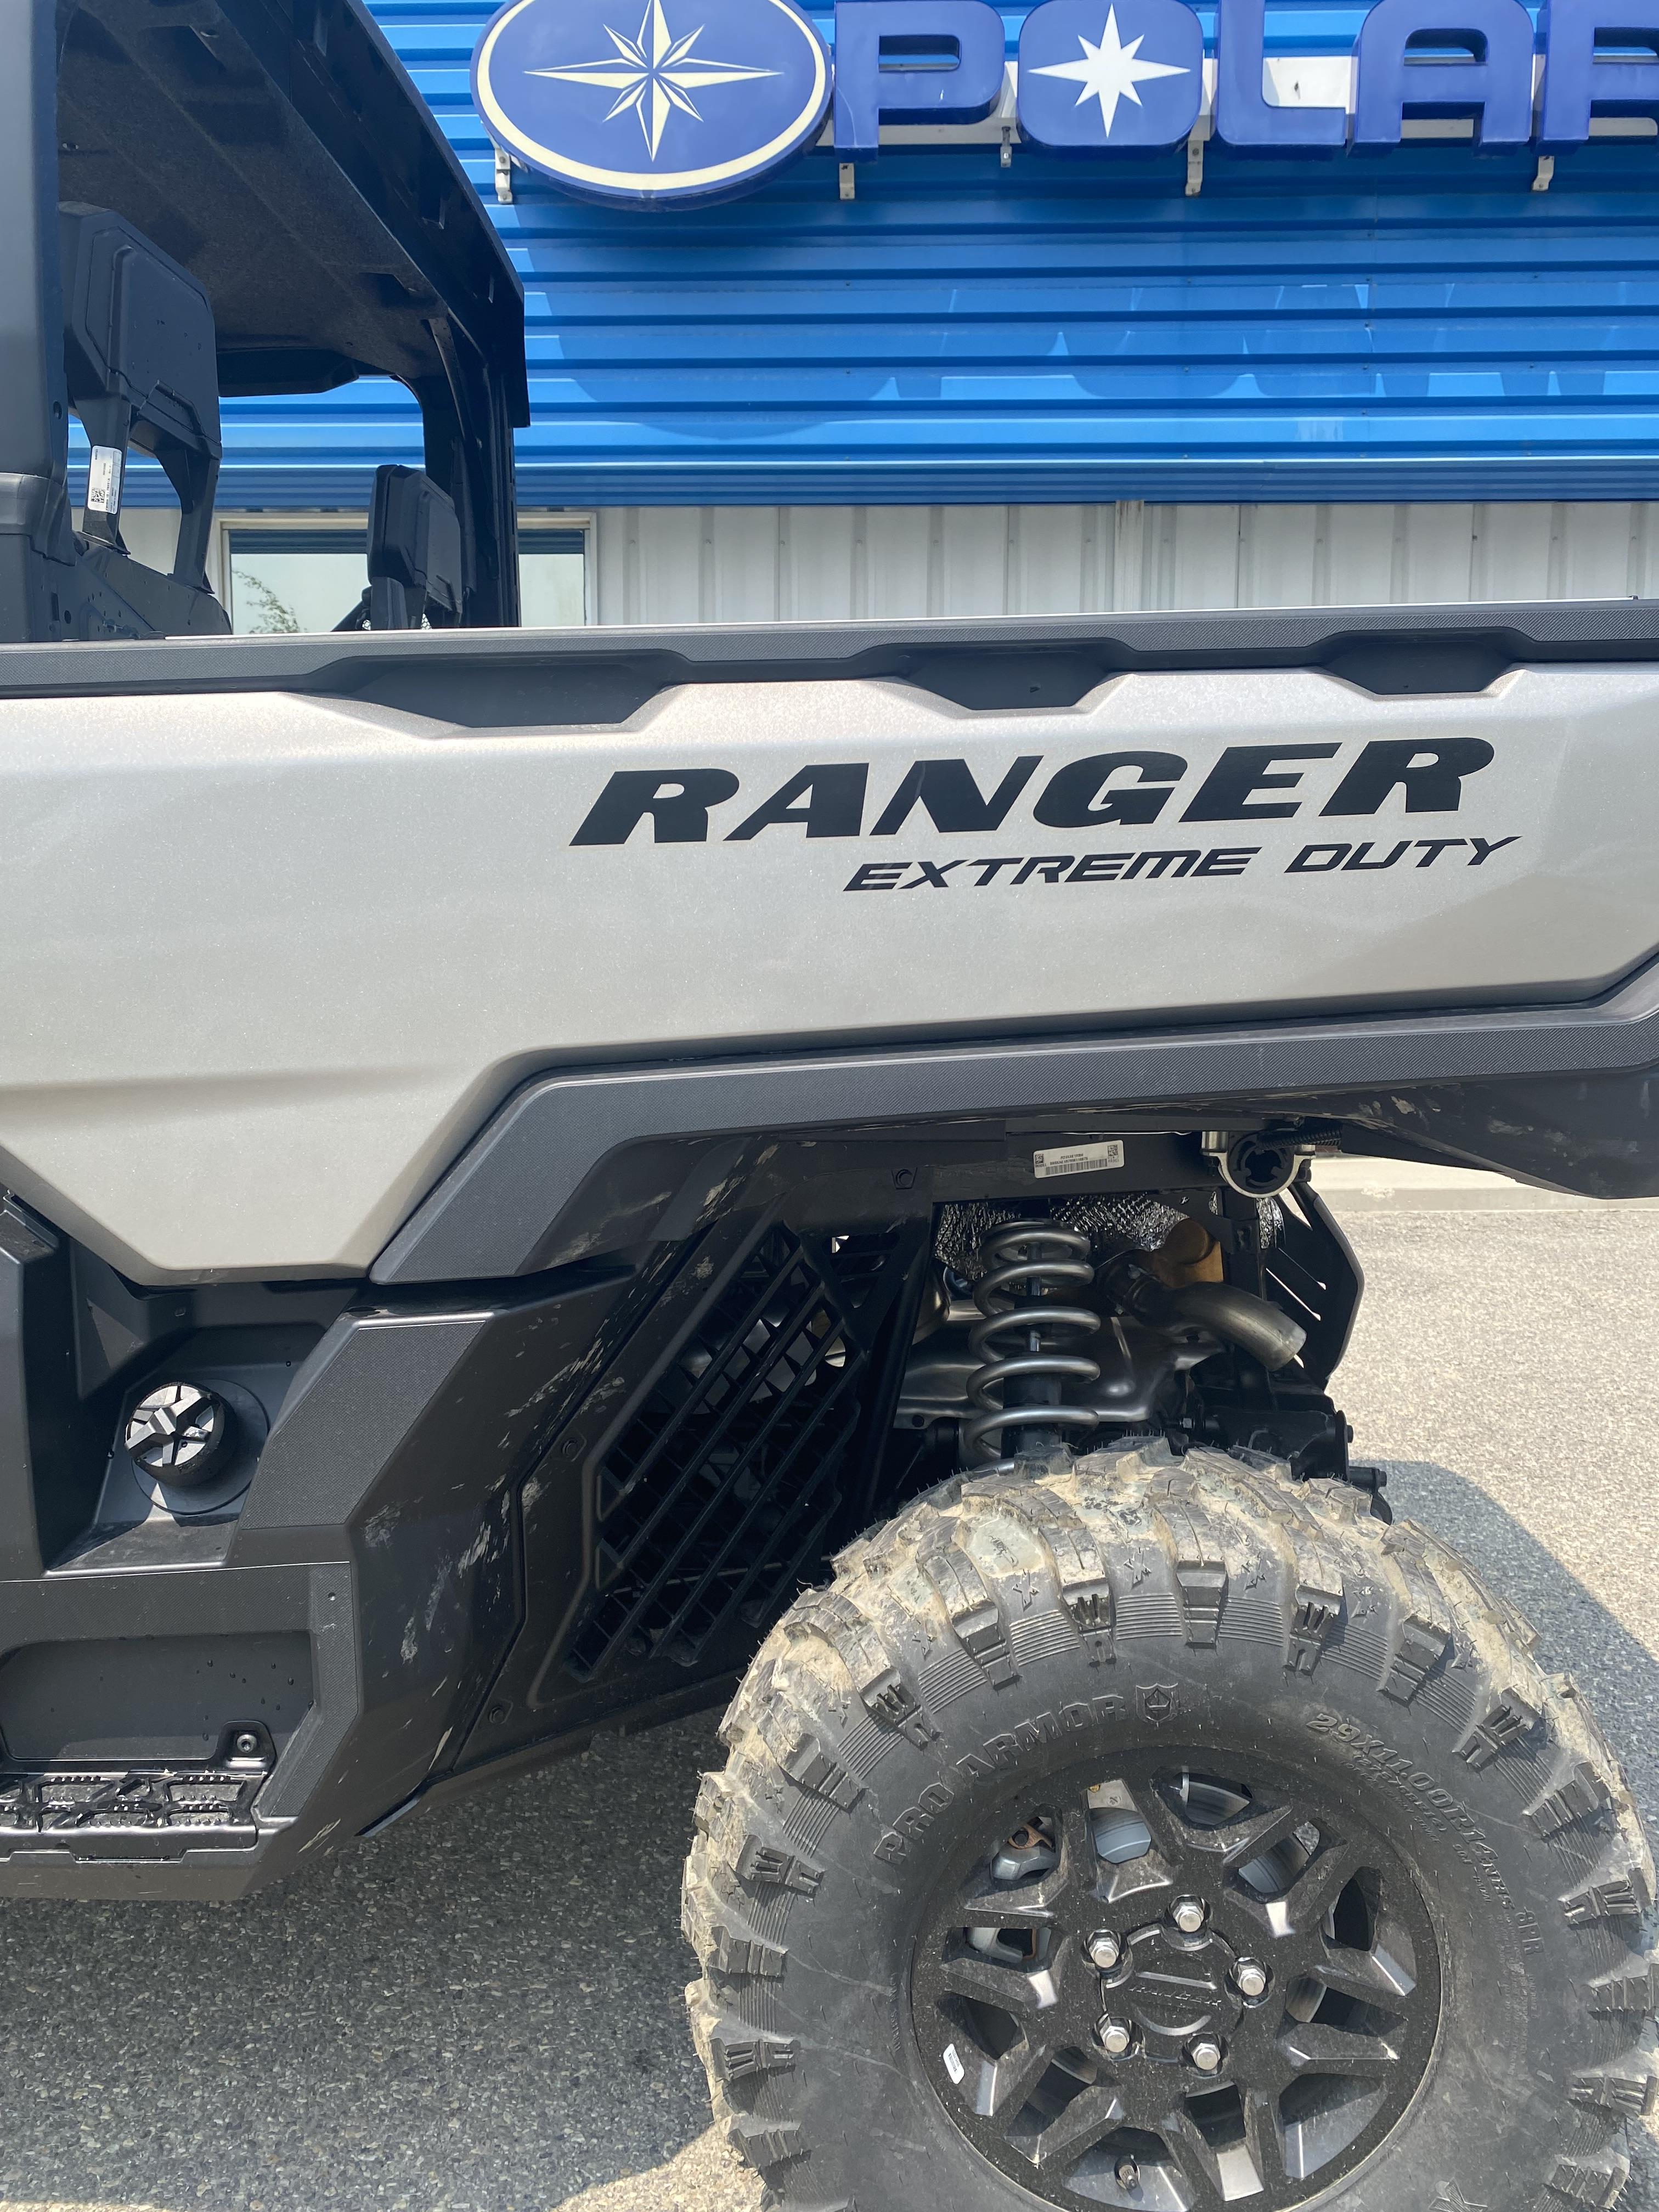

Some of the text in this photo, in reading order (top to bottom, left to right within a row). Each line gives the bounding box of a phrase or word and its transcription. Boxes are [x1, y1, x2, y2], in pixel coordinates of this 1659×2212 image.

[569, 738, 1494, 846] RANGER
[844, 836, 1519, 891] EXTREME DUTY
[873, 1693, 1126, 1865] PRO ARMOR
